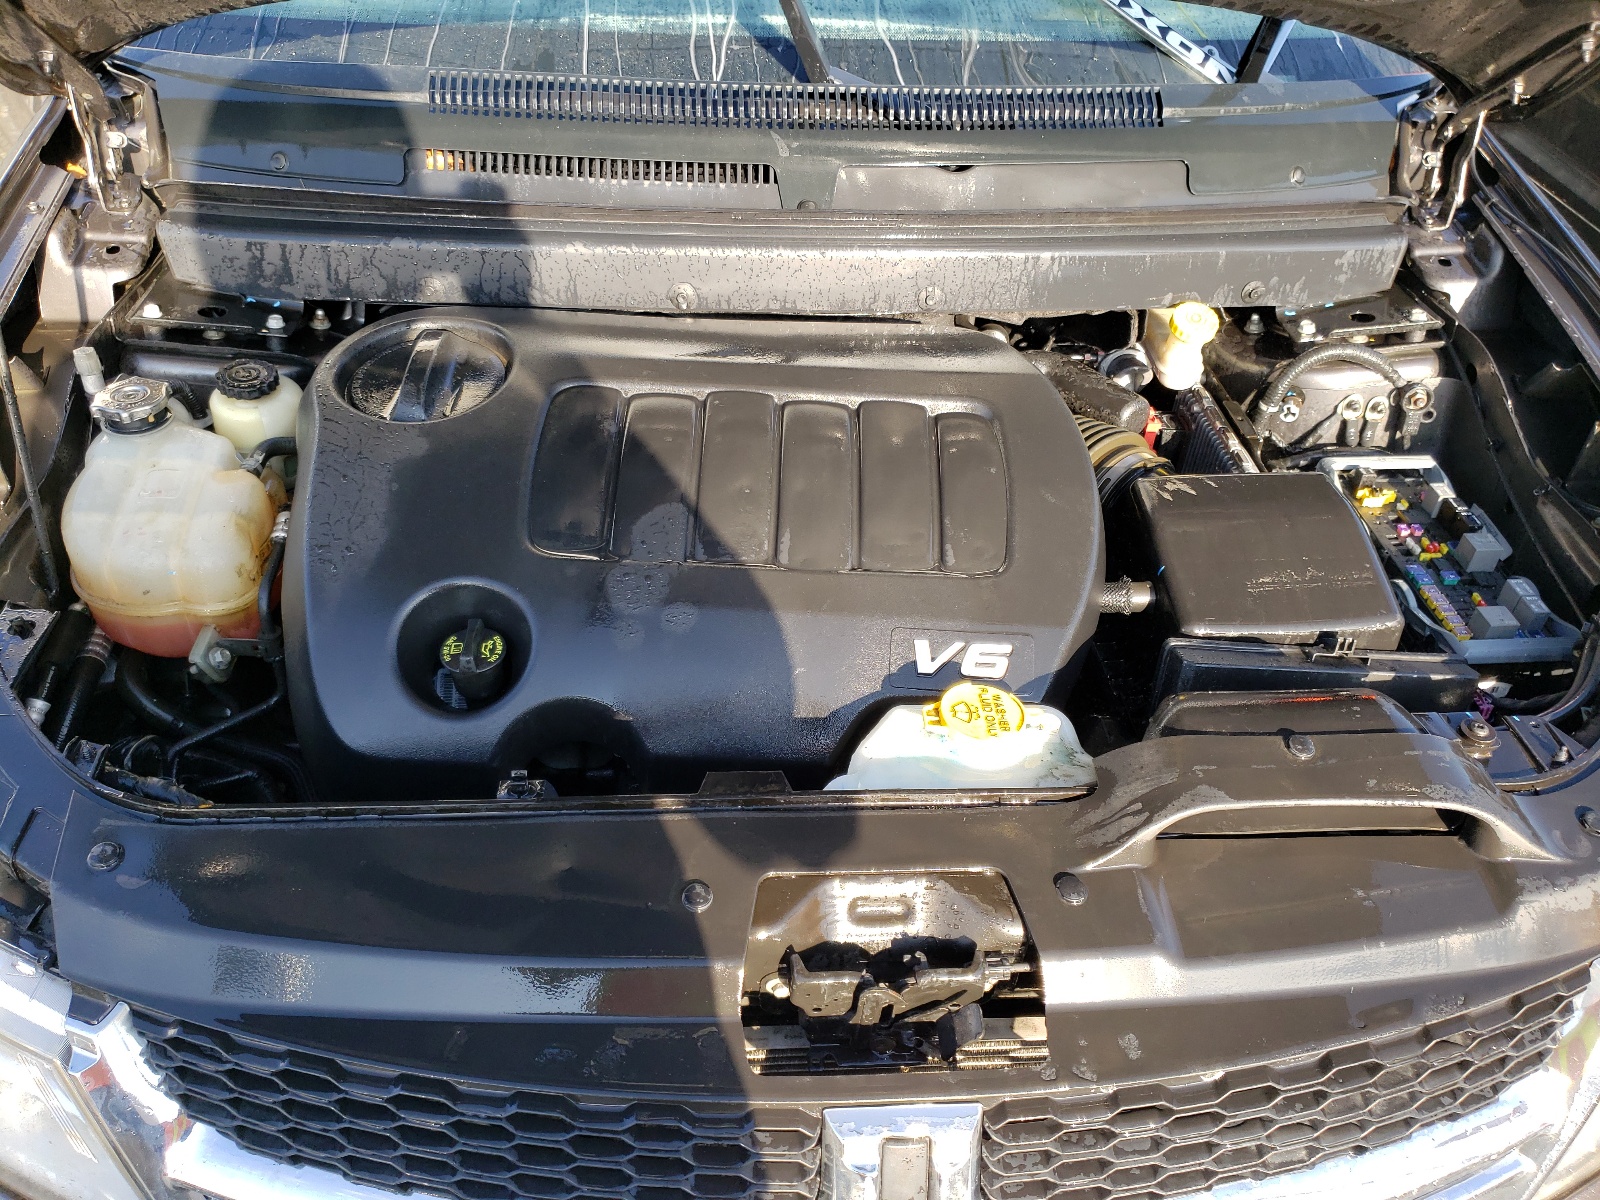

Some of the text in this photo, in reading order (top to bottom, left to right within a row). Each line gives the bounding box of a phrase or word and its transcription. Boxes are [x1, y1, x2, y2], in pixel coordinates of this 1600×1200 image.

[488, 636, 503, 662] ENGINE OIL
[913, 639, 1013, 681] V6
[979, 688, 998, 737] FLUID ONLY
[992, 694, 1010, 731] WASHER
